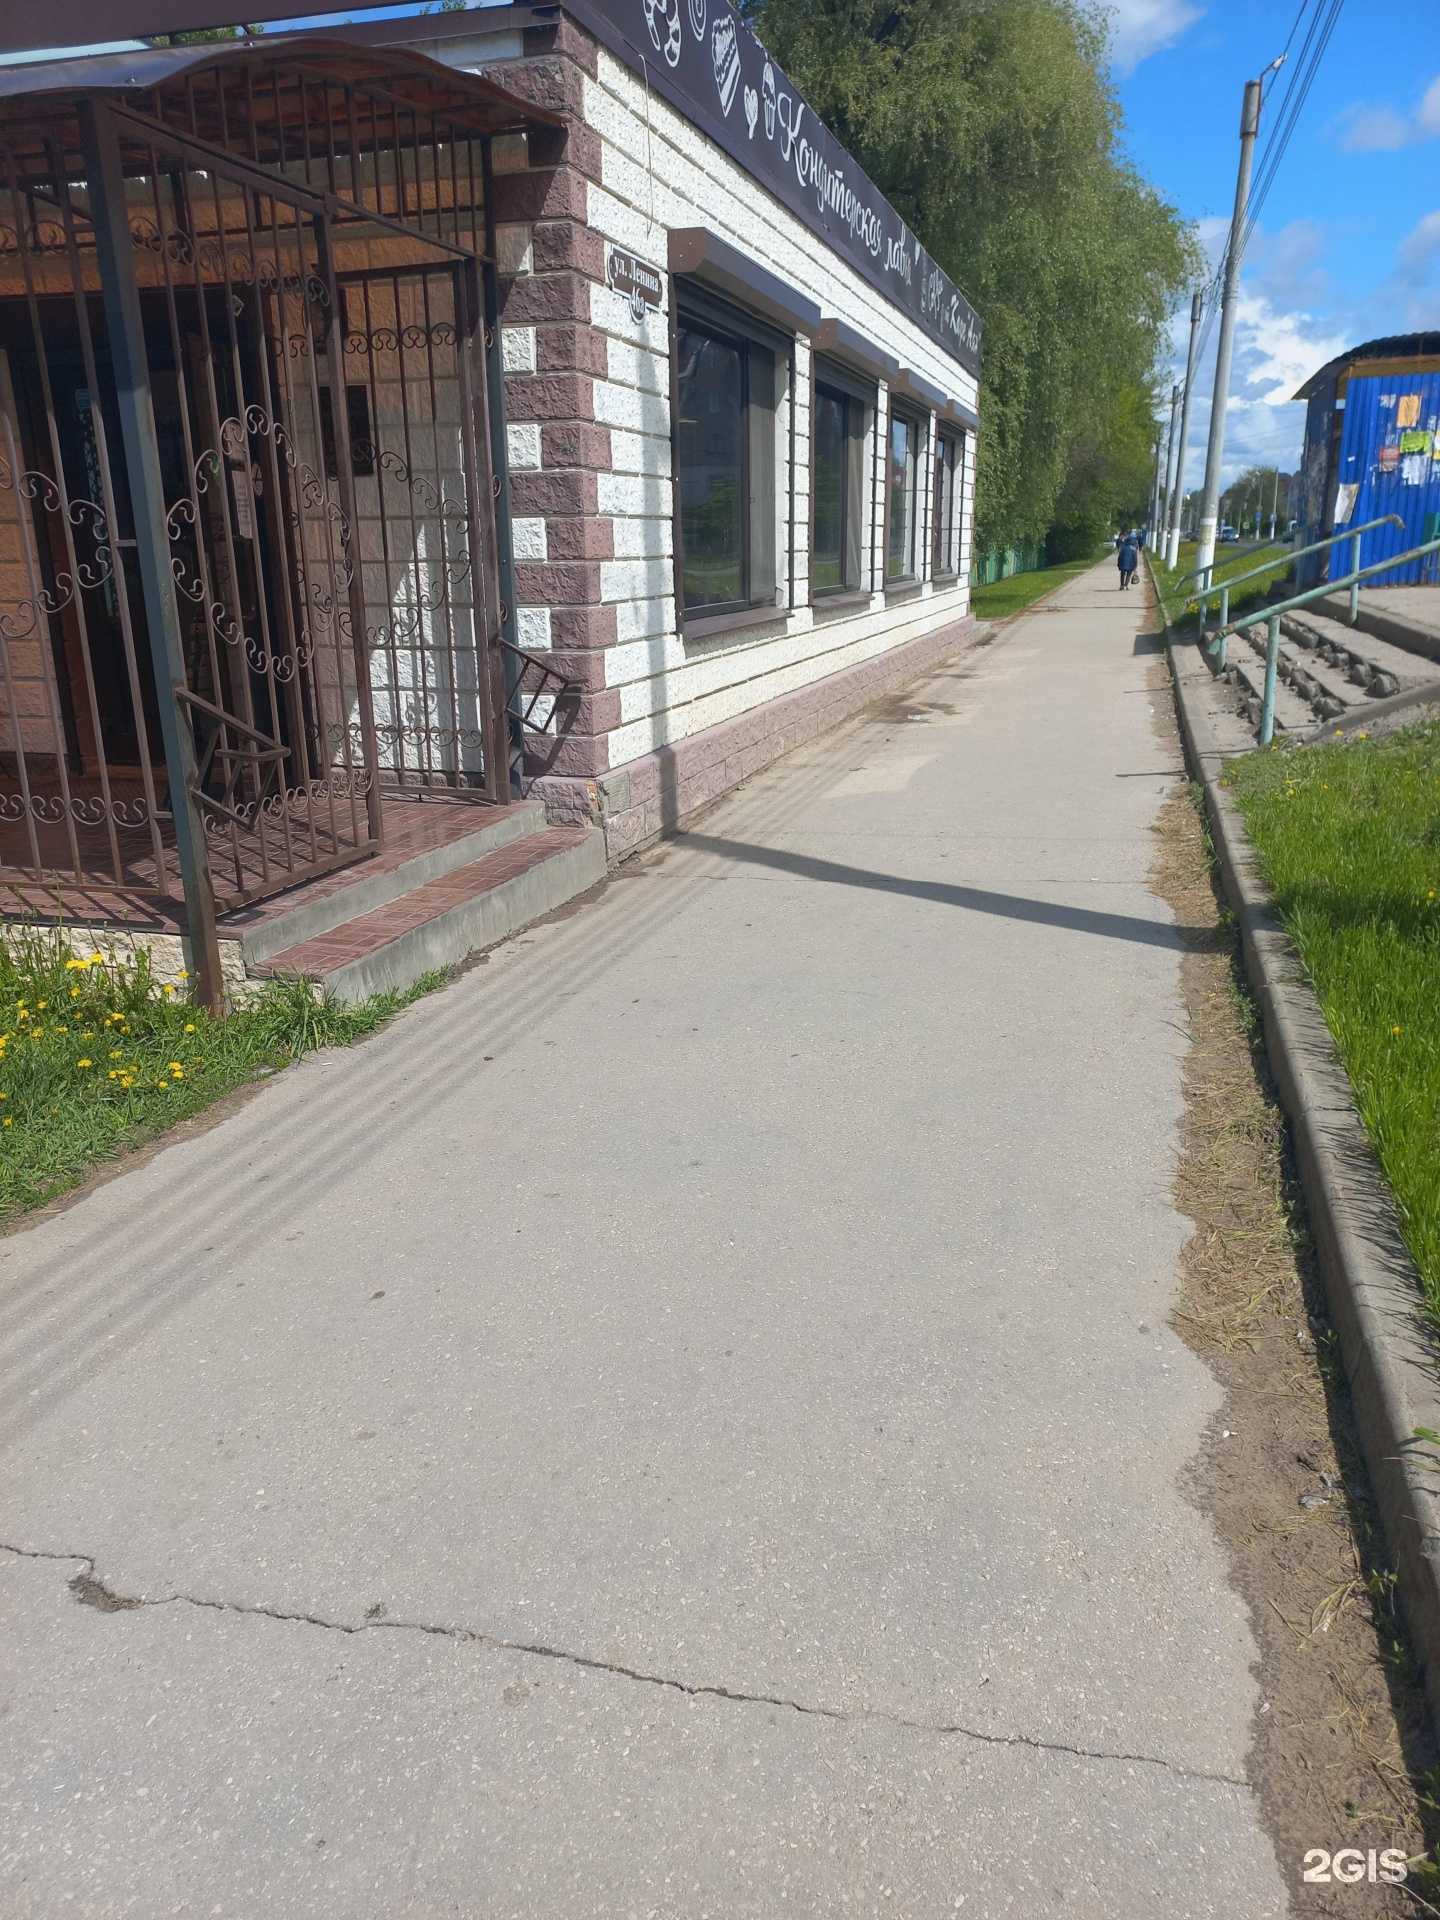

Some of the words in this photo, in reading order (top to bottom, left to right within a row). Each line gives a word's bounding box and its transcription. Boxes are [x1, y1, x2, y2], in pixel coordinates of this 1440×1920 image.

[777, 92, 882, 257] Кондитерская
[614, 256, 628, 278] ул.
[629, 259, 659, 293] Ленина
